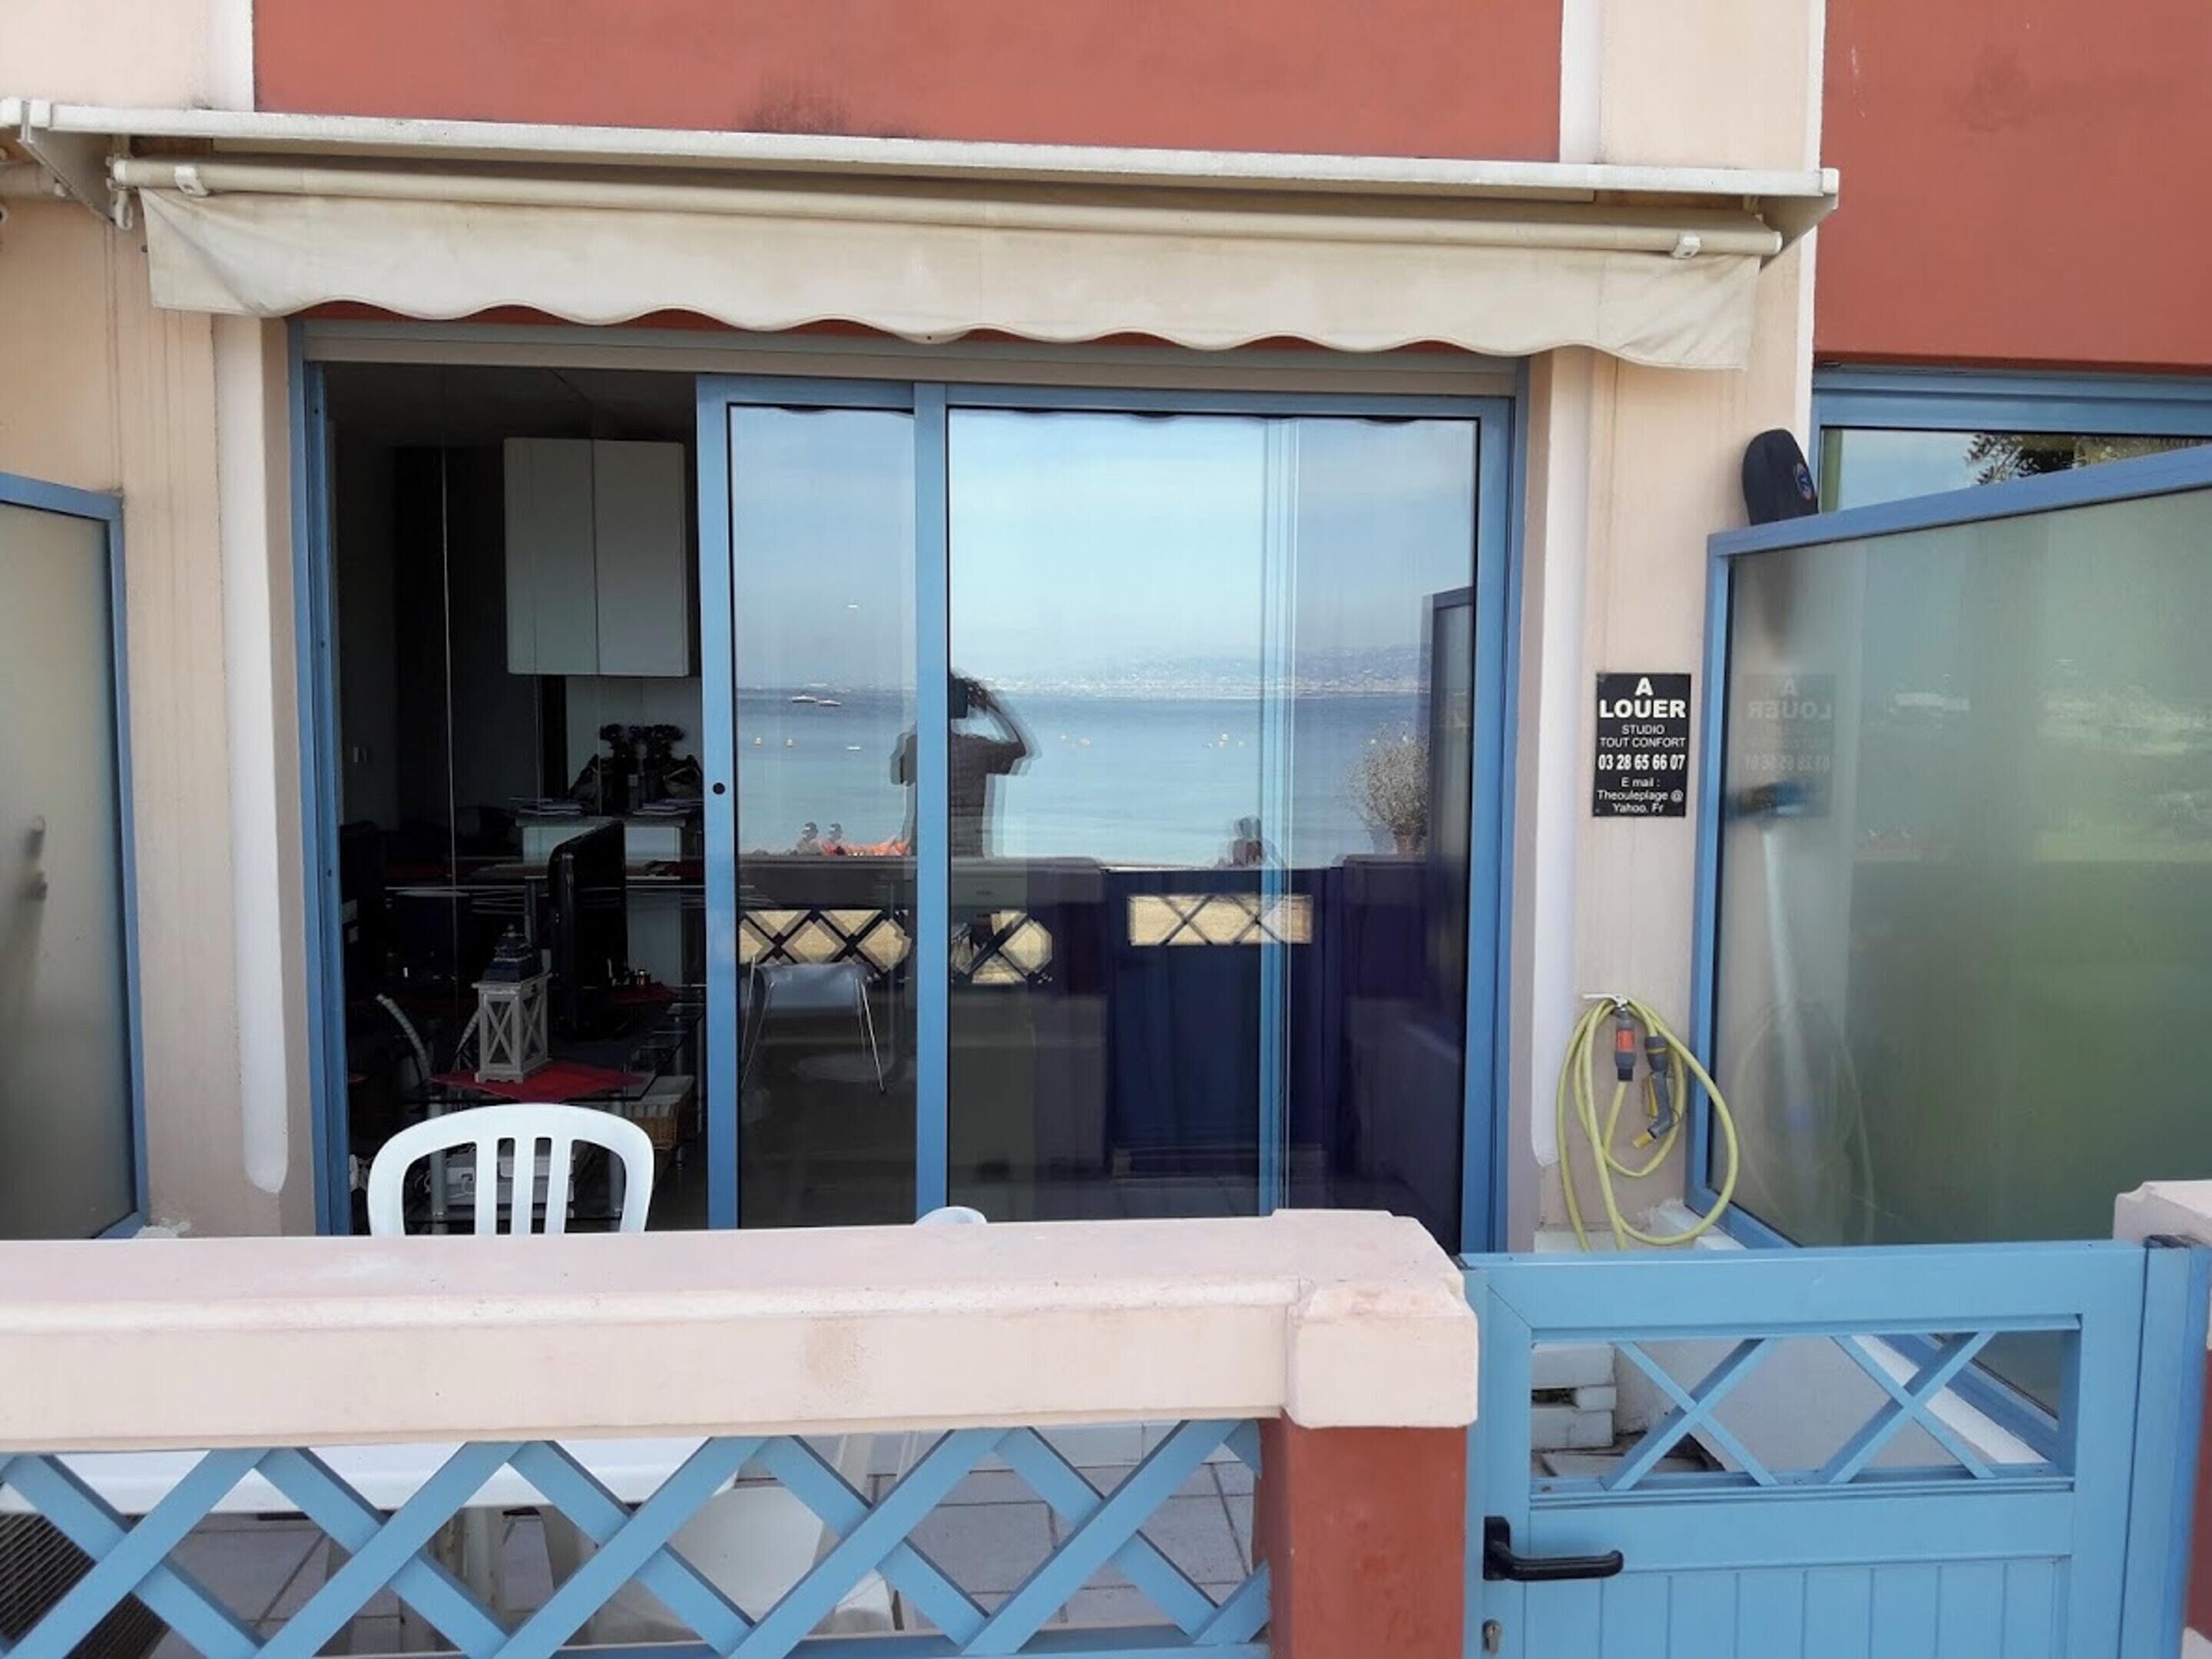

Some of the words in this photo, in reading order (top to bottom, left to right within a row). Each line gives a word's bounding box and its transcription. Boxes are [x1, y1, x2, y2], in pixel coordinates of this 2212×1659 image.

[1634, 677, 1654, 696] A
[1600, 700, 1686, 718] LOUER
[1621, 724, 1665, 735] STUDIO
[1600, 737, 1630, 748] TOUT
[1632, 737, 1686, 748] CONFORT
[1598, 754, 1614, 770] 03
[1616, 754, 1631, 770] 28
[1634, 754, 1649, 770] 65
[1652, 754, 1667, 770] 66
[1670, 754, 1686, 770] 07
[1621, 777, 1630, 787] E
[1632, 777, 1654, 787] mail
[1670, 790, 1684, 803] @
